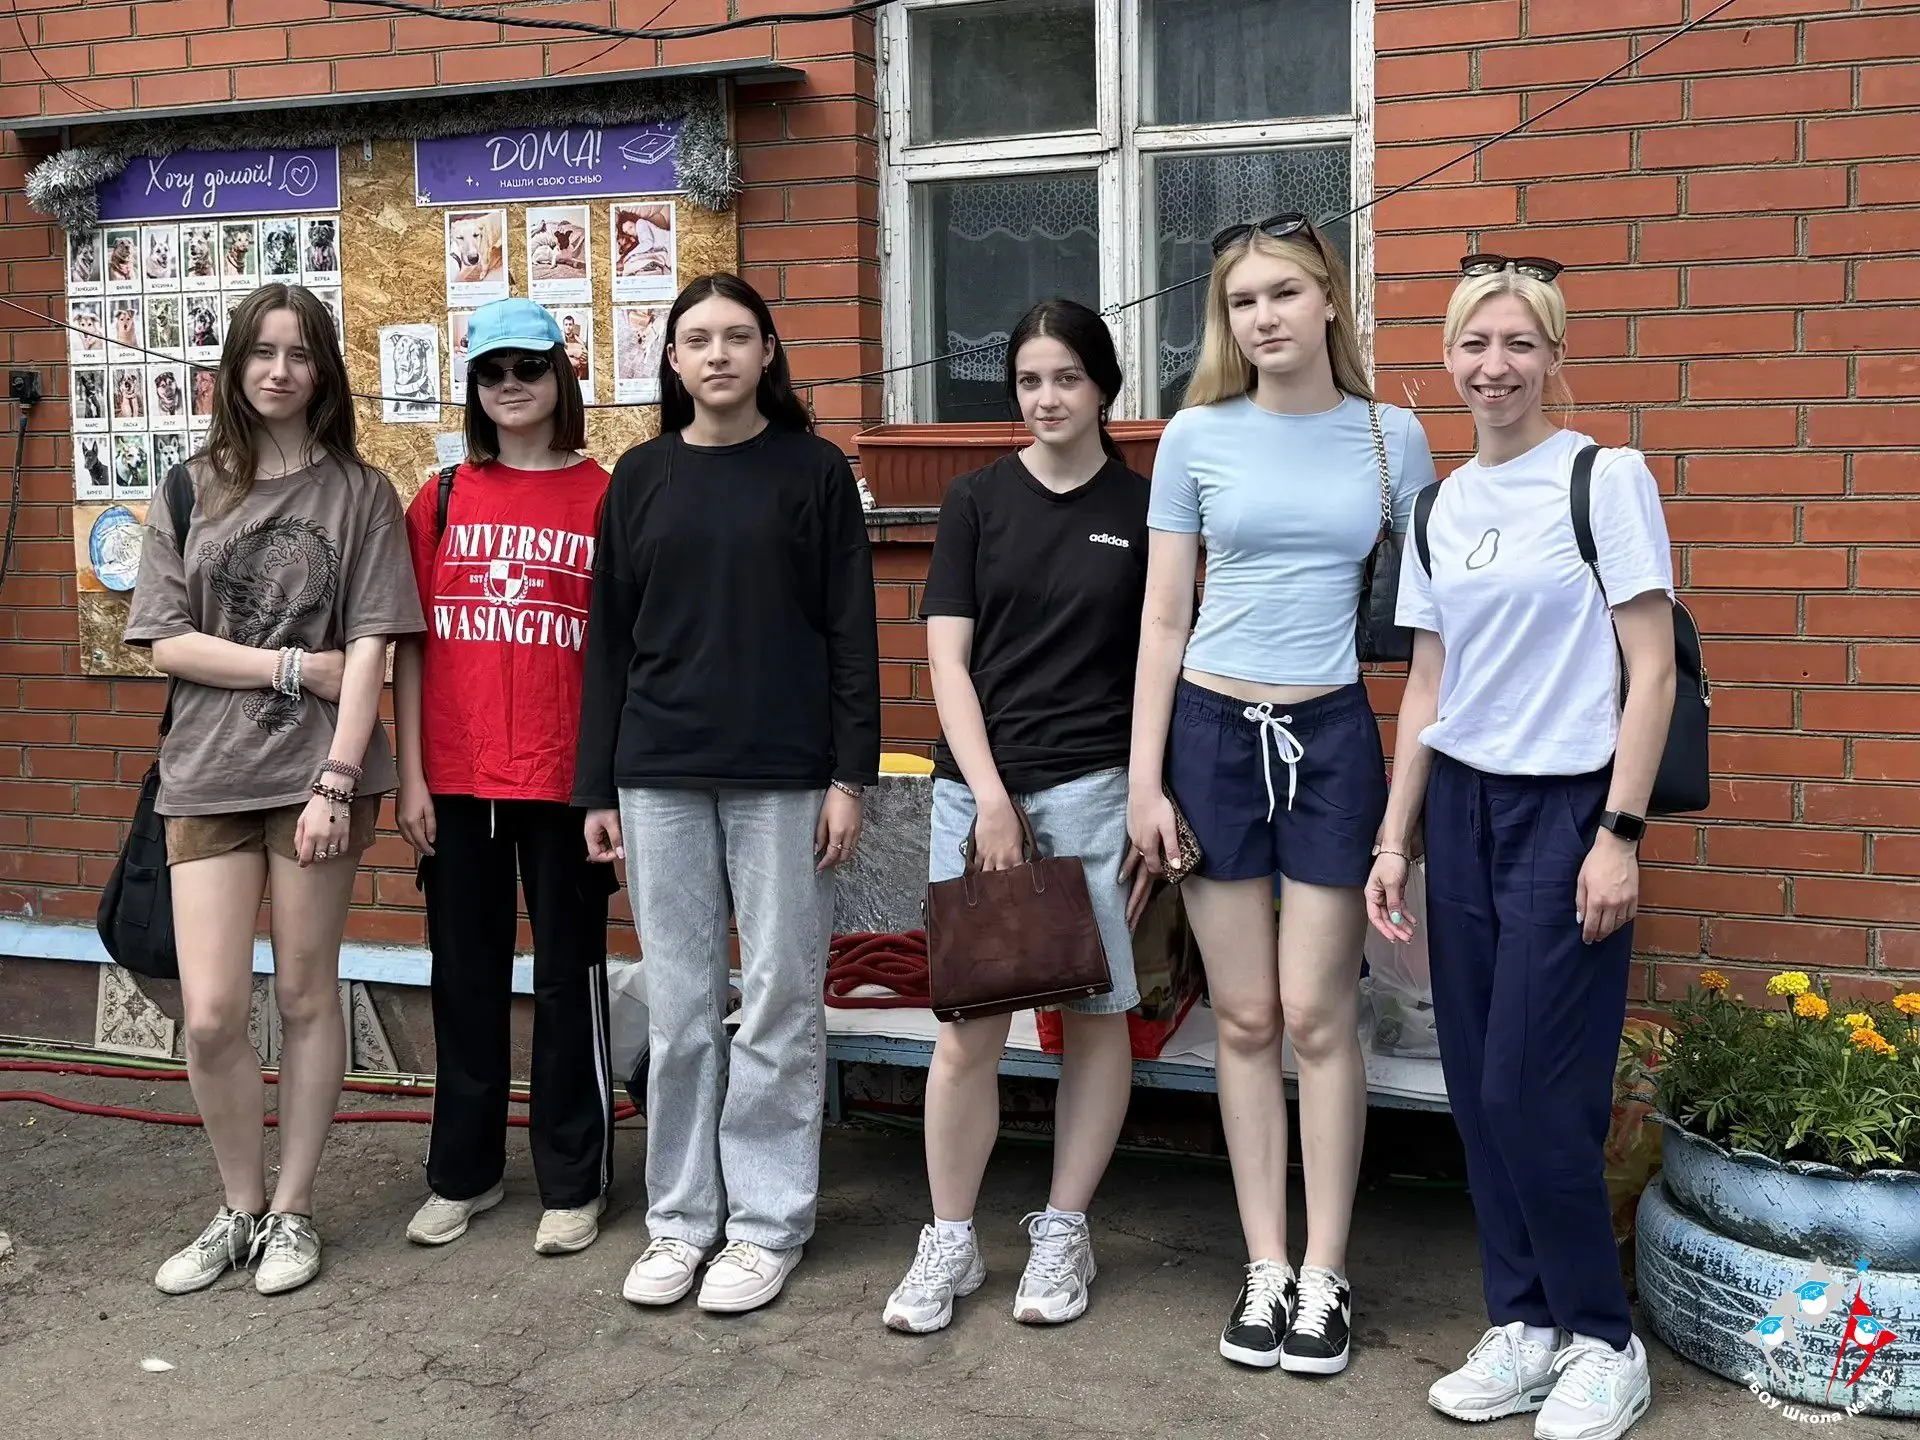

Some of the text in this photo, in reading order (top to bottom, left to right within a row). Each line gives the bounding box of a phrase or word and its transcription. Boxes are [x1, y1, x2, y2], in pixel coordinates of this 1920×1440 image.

[485, 129, 602, 171] ДОМА!
[145, 152, 275, 208] Хочу домой!
[500, 174, 603, 188] НАШЛИ СВОЮ СЕМЬЮ
[1089, 533, 1129, 548] adidas
